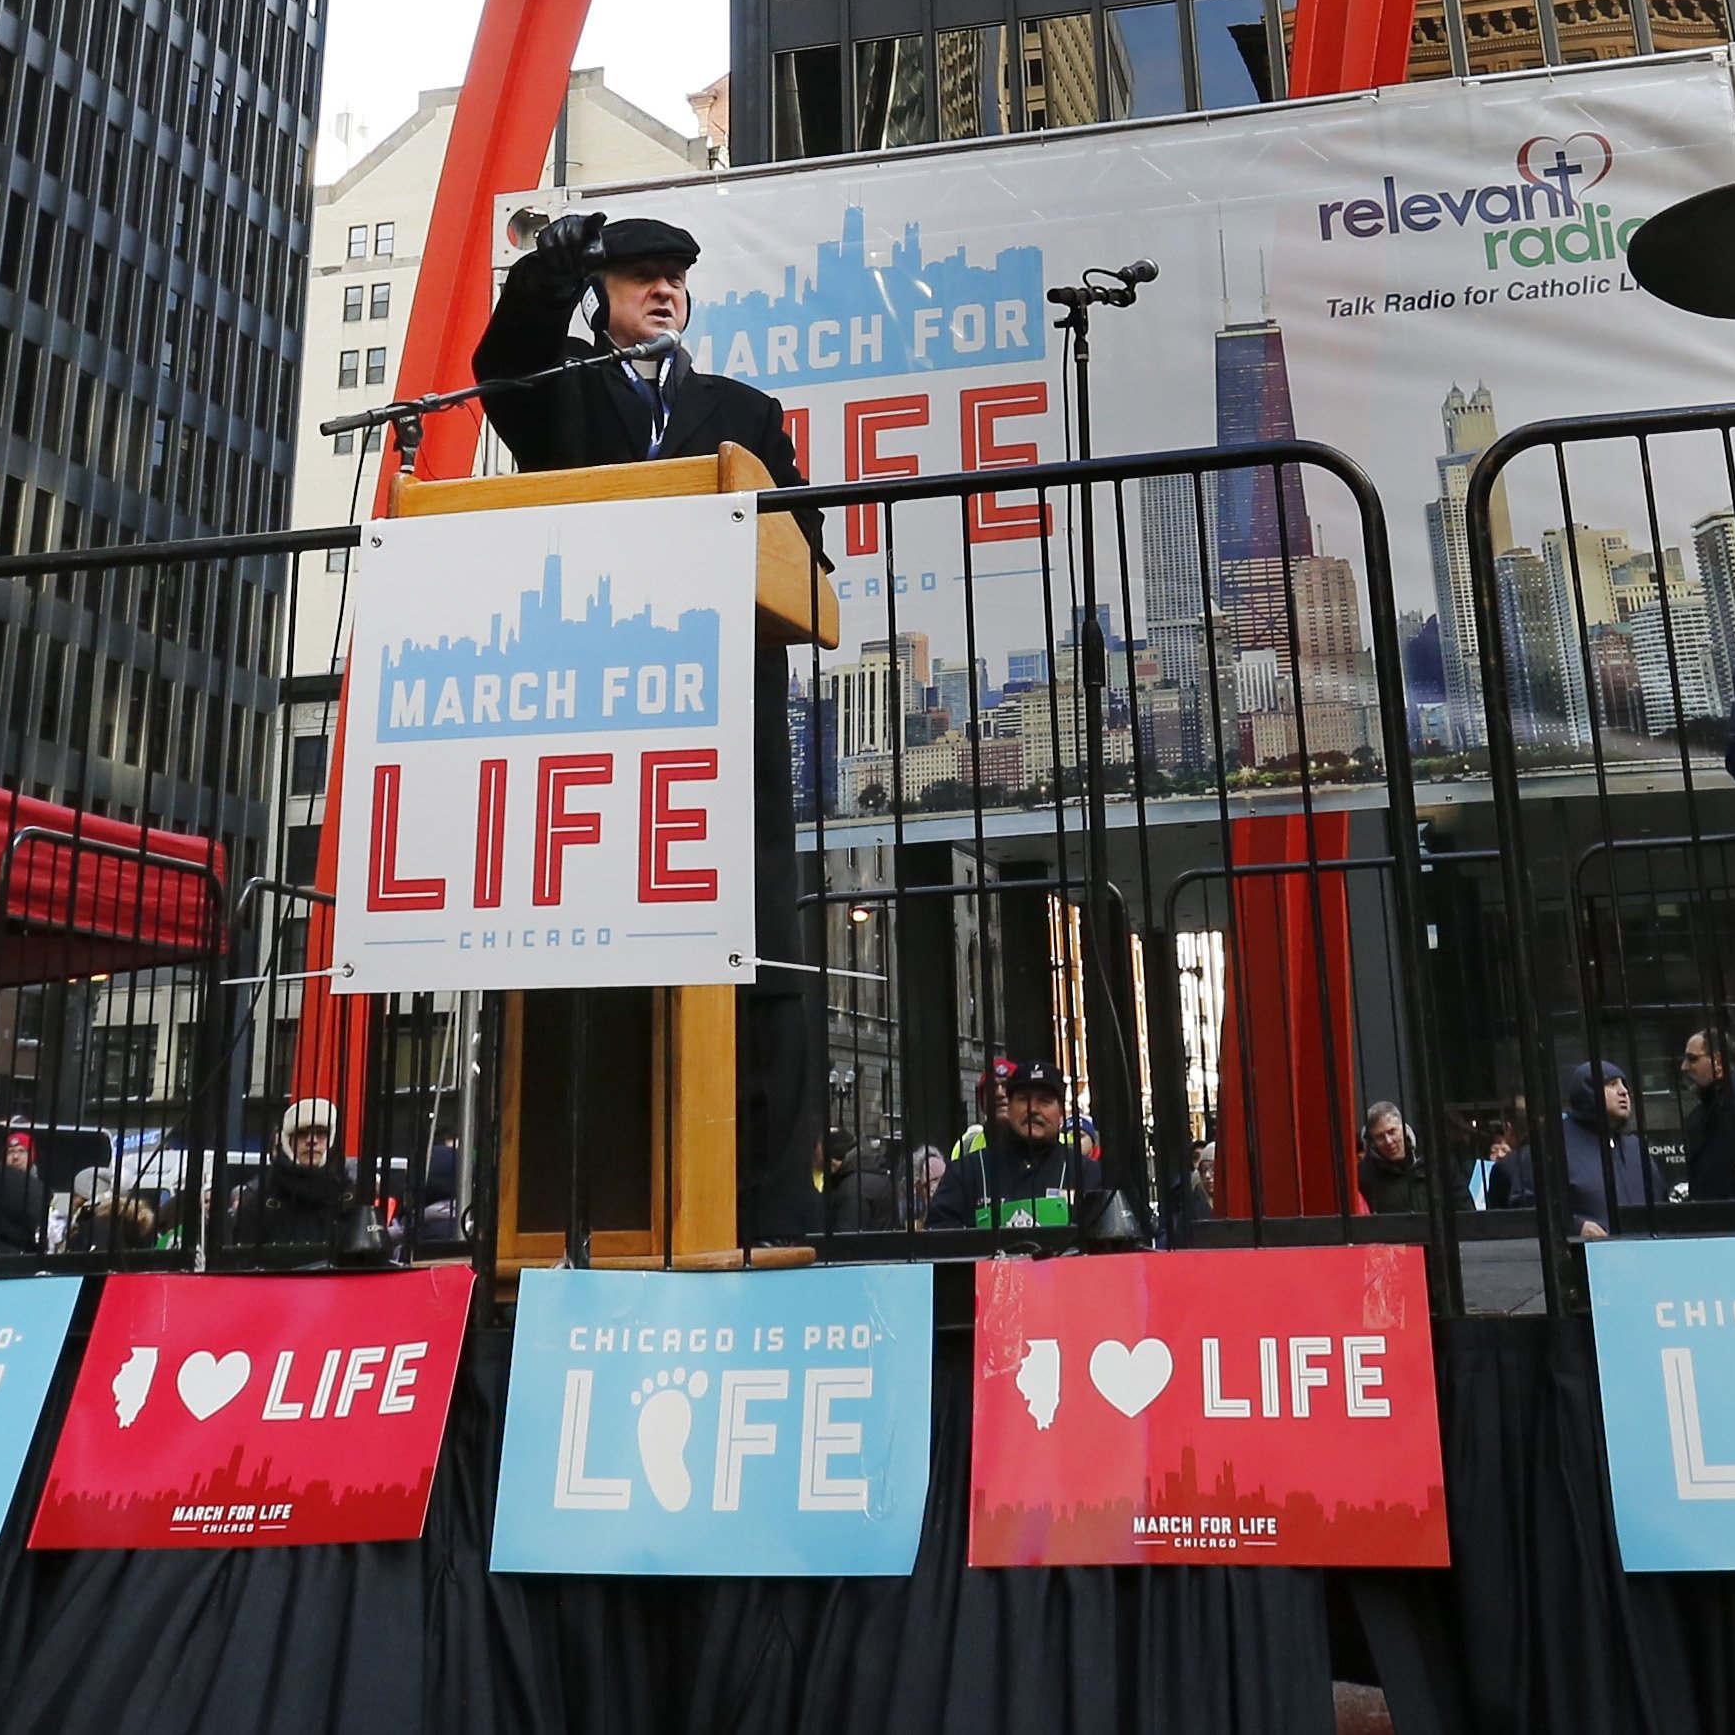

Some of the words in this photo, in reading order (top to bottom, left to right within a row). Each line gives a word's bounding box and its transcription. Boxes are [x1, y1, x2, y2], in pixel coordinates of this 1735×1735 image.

[1317, 150, 1584, 242] relevant
[1326, 295, 1376, 319] Talk
[1383, 288, 1457, 314] Radio
[1463, 285, 1500, 307] for
[1506, 273, 1612, 303] Catholic
[681, 312, 886, 380] MARCH
[913, 298, 1030, 360] FOR
[837, 570, 937, 601] CAGO
[388, 667, 577, 729] MARCH
[601, 661, 705, 717] FOR
[366, 747, 719, 913] LIFE
[459, 927, 614, 950] CHICAGO
[569, 1324, 736, 1355] CHICAGO
[753, 1324, 786, 1352] IS
[260, 1339, 431, 1423] LIFE
[1201, 1334, 1394, 1420] LIFE
[171, 1504, 225, 1523] MARCH
[227, 1504, 257, 1522] FOR
[259, 1503, 294, 1521] LIFE
[201, 1523, 255, 1534] CHICAGO
[1133, 1515, 1194, 1534] MARCH
[1199, 1515, 1234, 1535] FOR
[1238, 1516, 1278, 1535] LIFE
[1173, 1537, 1238, 1549] CHICAGO
